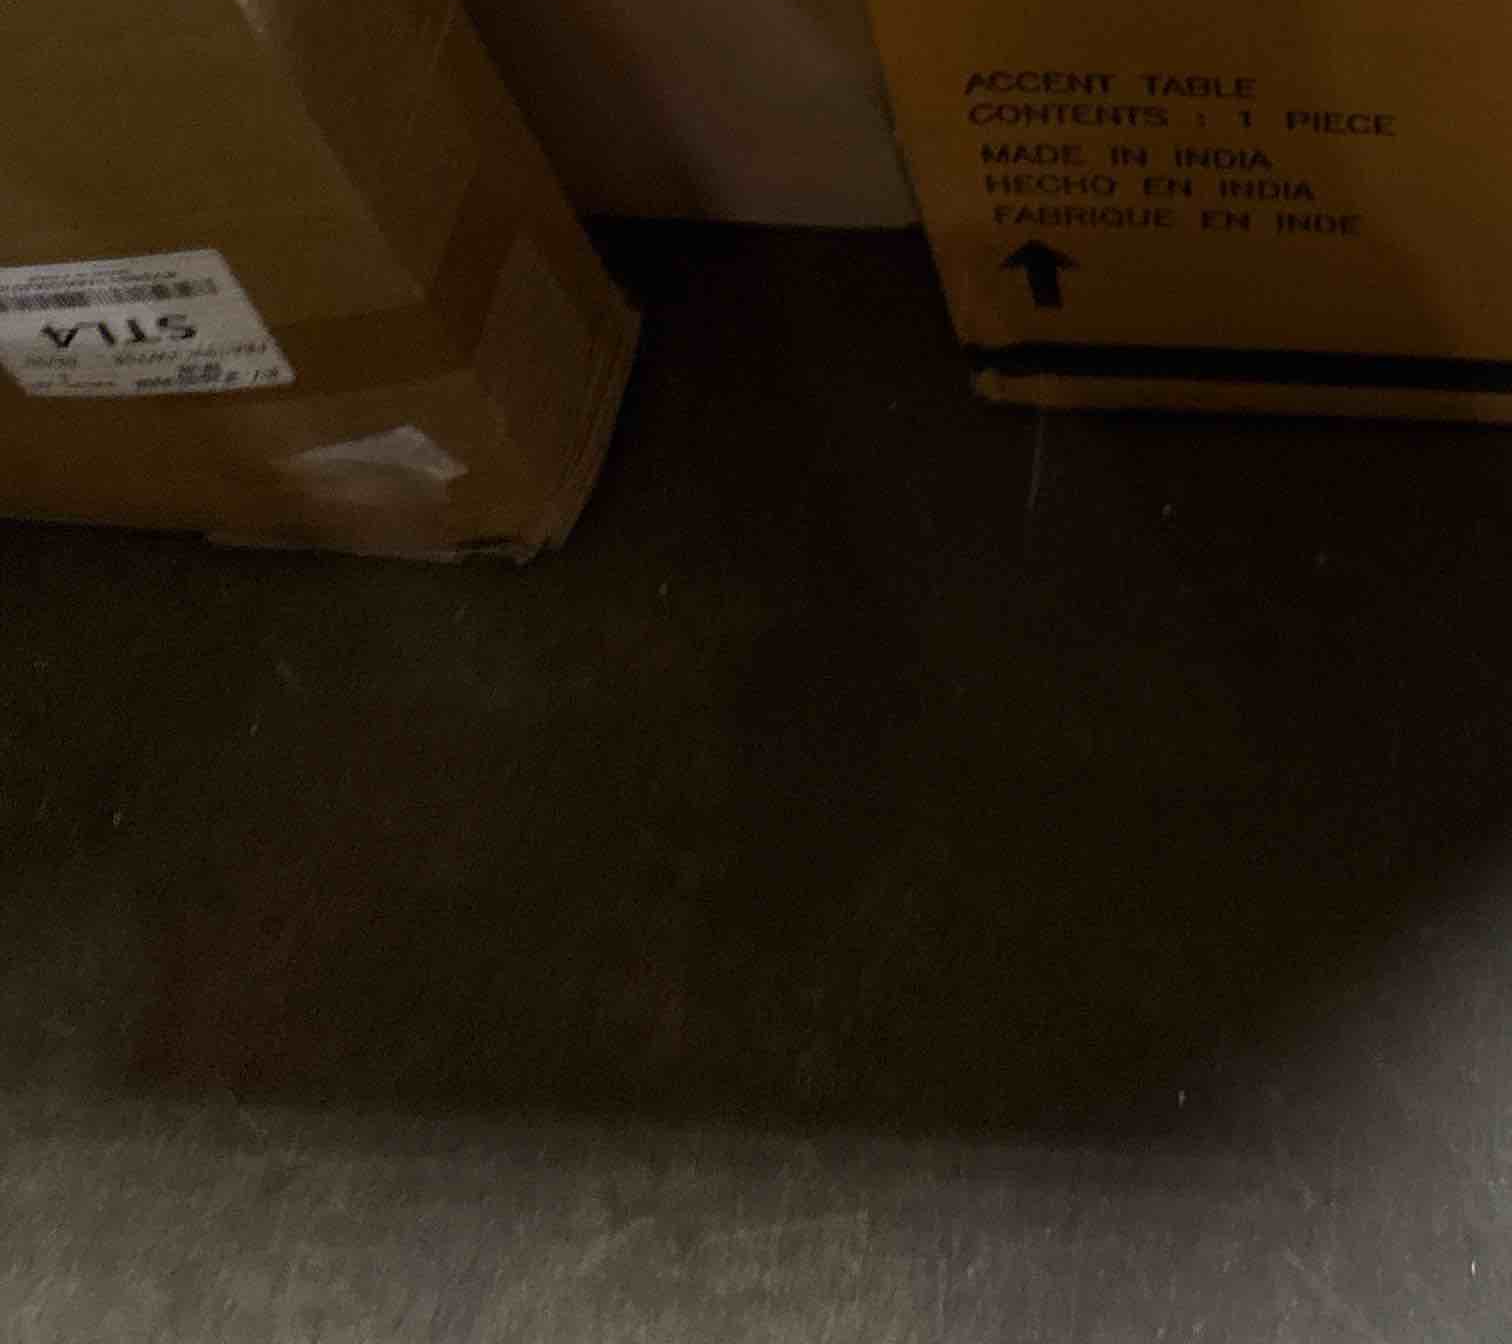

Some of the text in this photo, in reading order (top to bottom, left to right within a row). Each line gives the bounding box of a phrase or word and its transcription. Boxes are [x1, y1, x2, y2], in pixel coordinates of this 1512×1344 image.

[964, 71, 1258, 99] ACCENT TABLE
[967, 102, 1170, 129] CONTENTS
[1286, 111, 1398, 137] PIECE
[981, 143, 1274, 171] MADE IN INDIA
[985, 173, 1316, 203] HECHO EN INDIA
[992, 204, 1362, 237] FABRIQUE EN INDE
